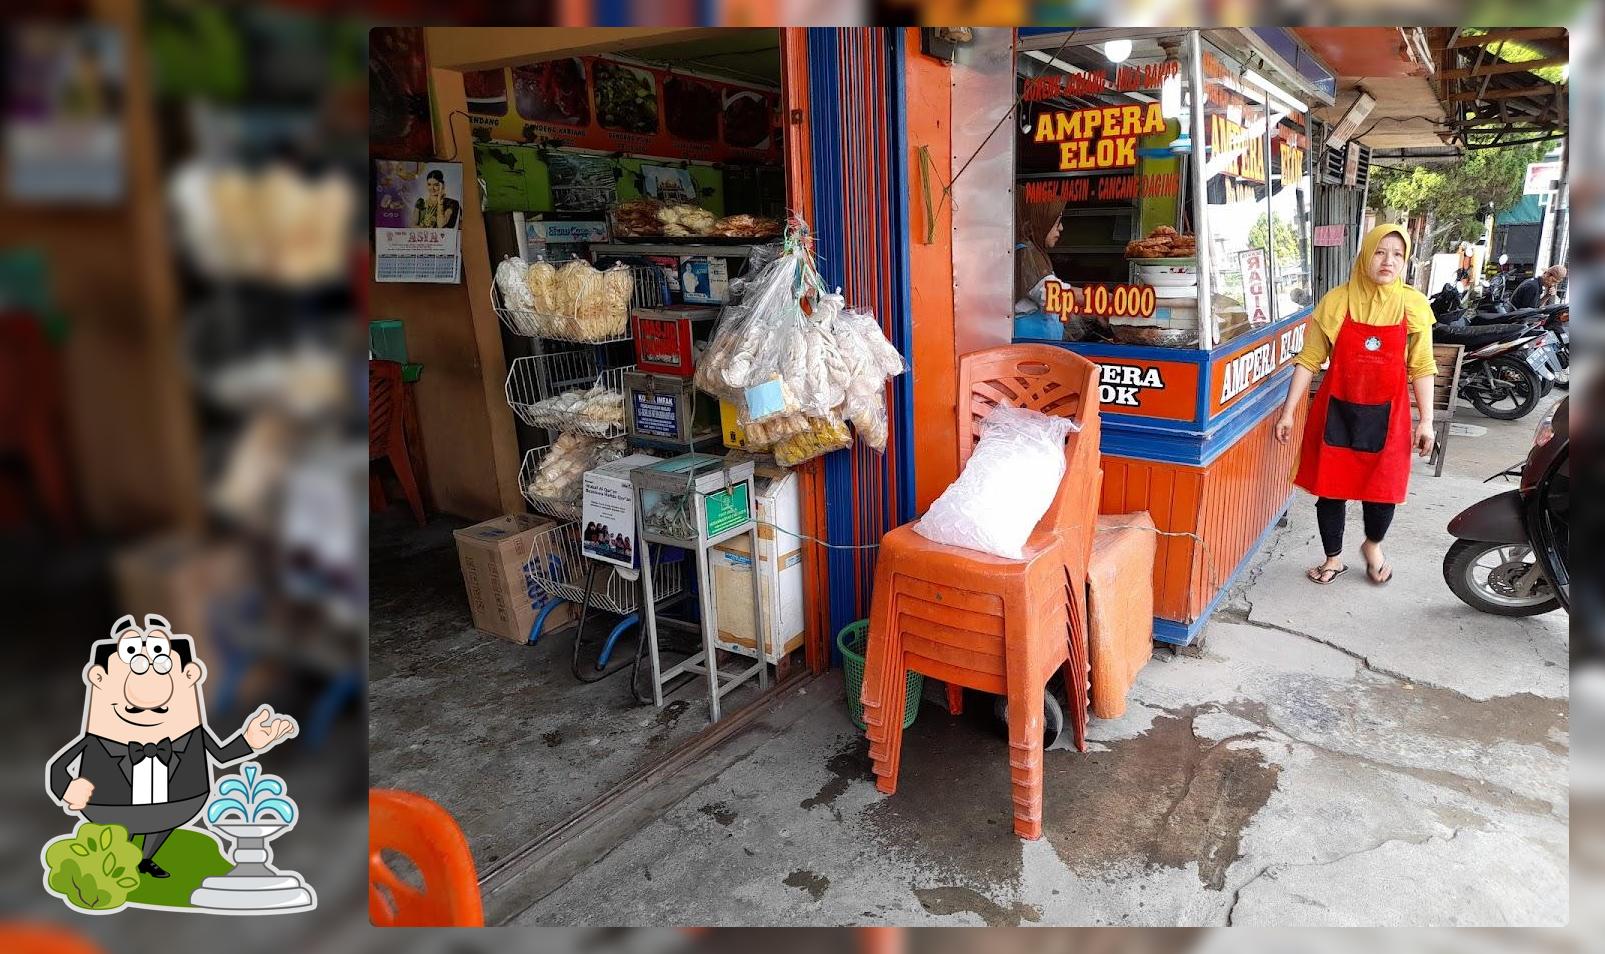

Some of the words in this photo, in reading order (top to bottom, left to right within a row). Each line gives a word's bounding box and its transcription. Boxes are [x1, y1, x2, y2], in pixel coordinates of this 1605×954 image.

[1034, 102, 1165, 143] AMPERA
[1060, 138, 1138, 171] ELOK
[1100, 364, 1164, 388] ERA
[1220, 339, 1276, 405] AMPERA
[1098, 384, 1140, 406] OK
